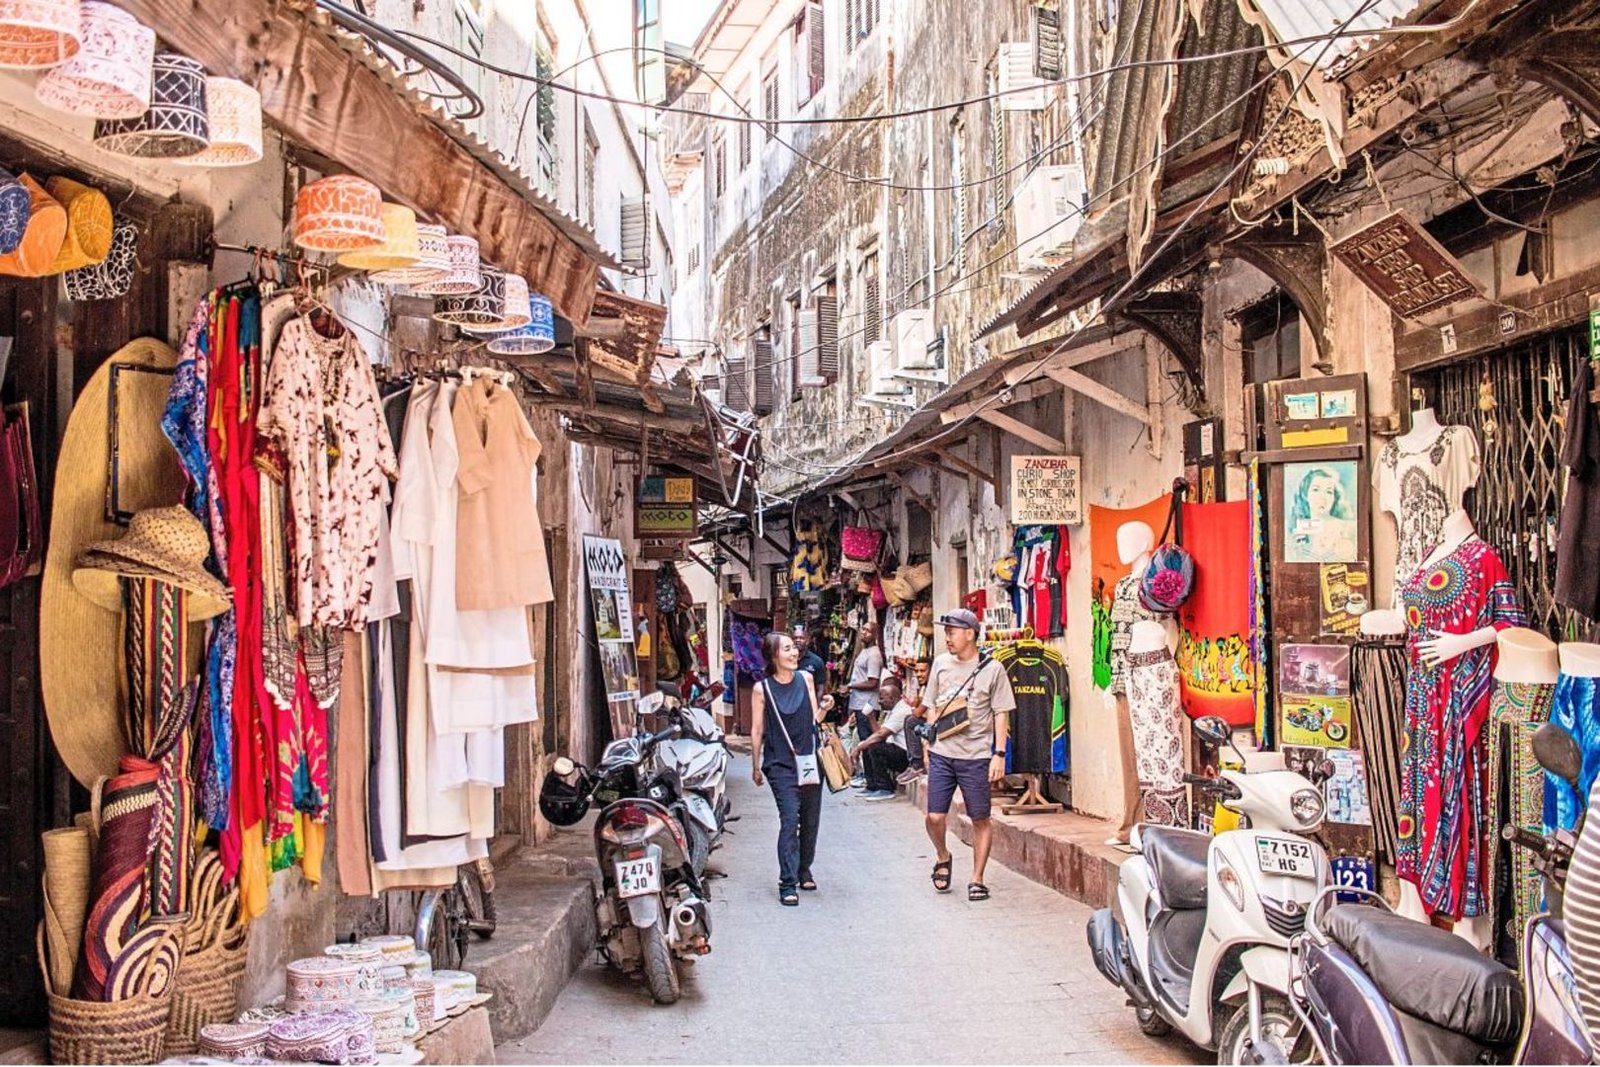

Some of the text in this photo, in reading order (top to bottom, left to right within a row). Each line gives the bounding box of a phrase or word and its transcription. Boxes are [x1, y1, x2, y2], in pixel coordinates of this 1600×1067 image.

[1024, 459, 1068, 469] ZANZIBAR
[1016, 469, 1076, 479] CURIO SHOP
[1017, 489, 1076, 499] IN STONE TOWN
[1270, 841, 1309, 859] Z 152
[1278, 858, 1297, 872] HG
